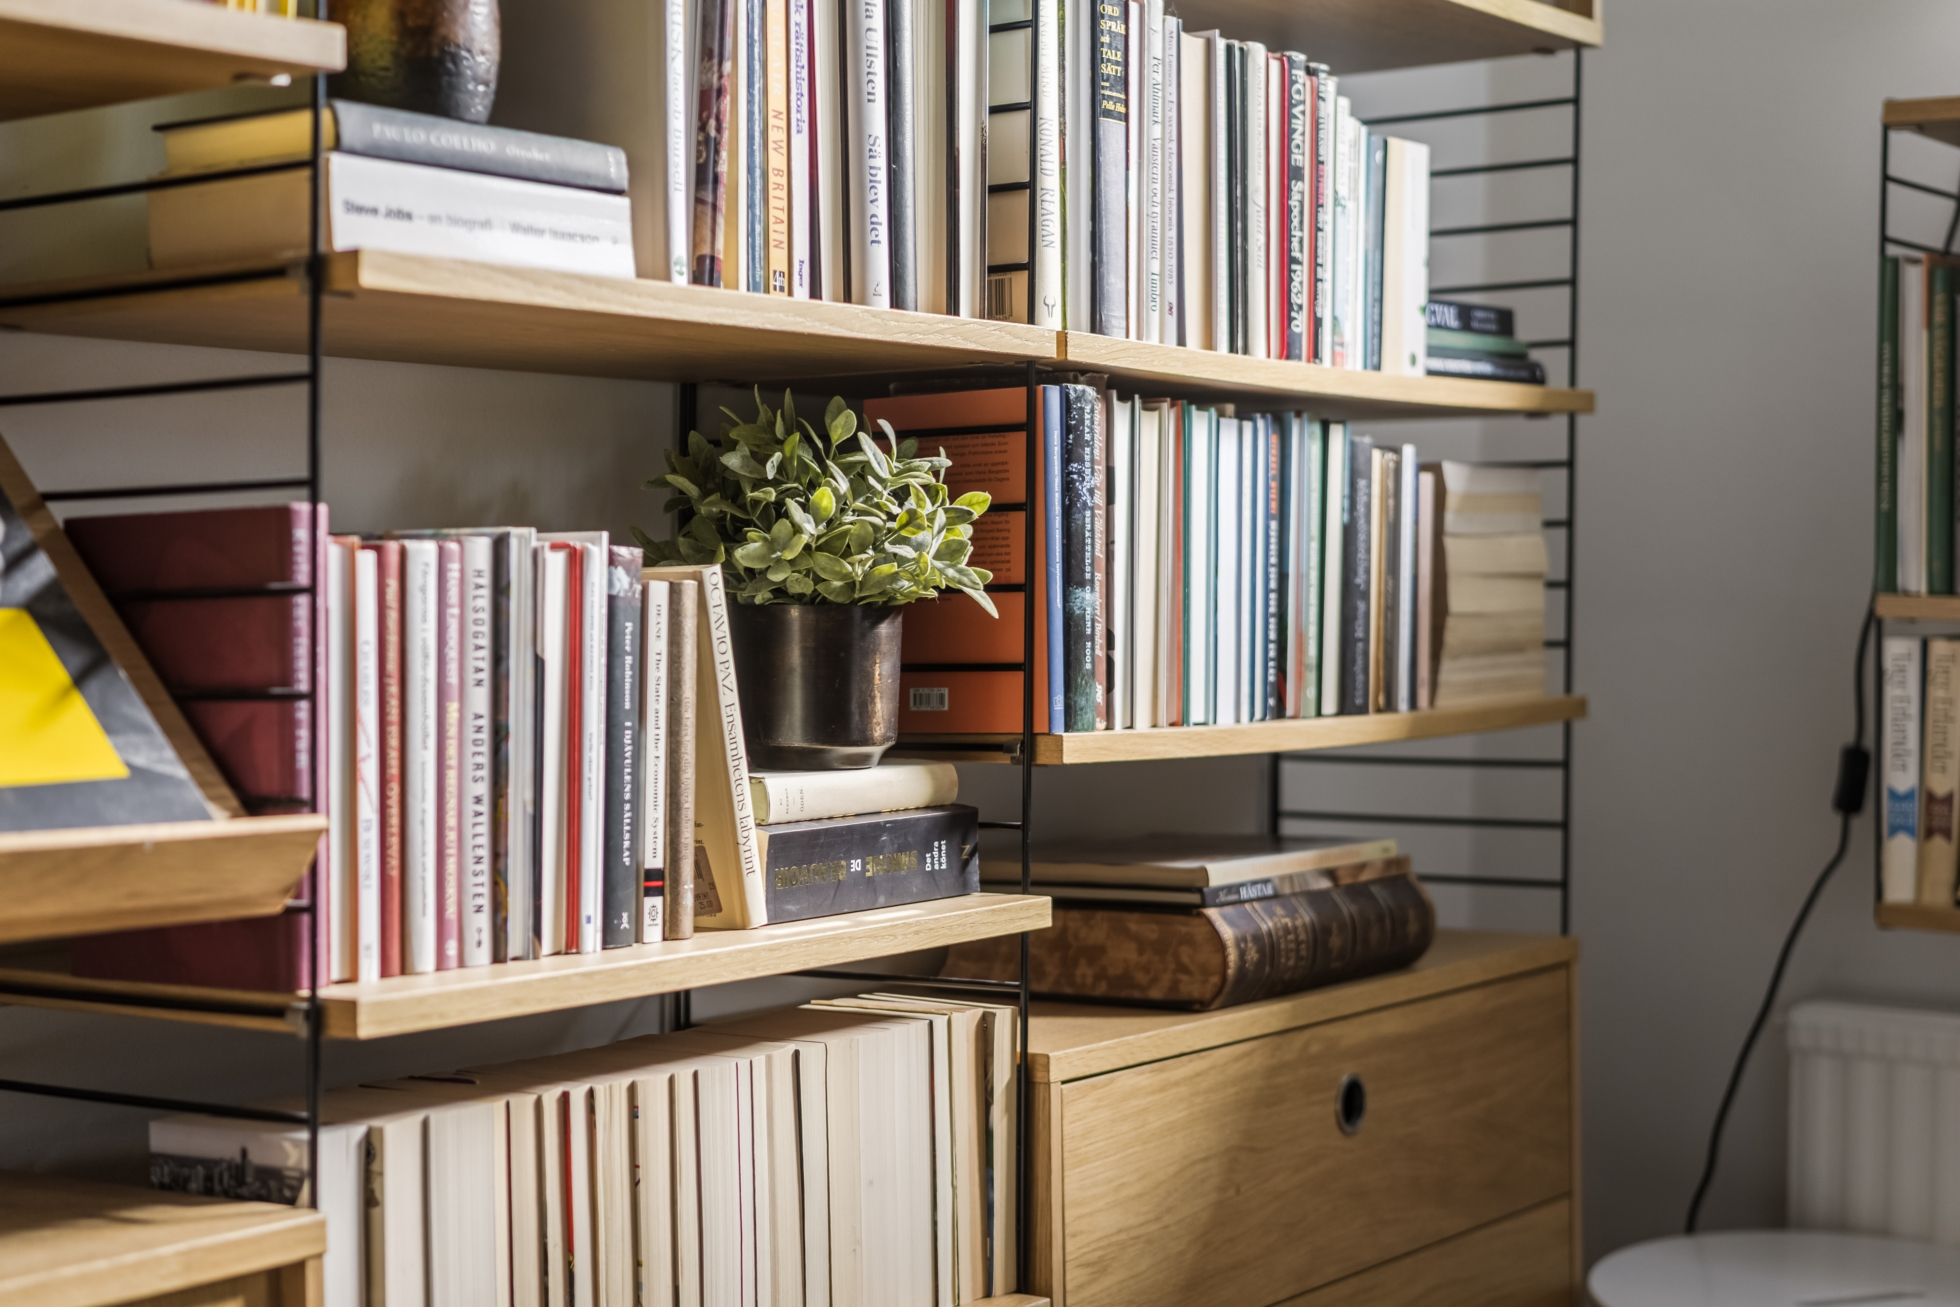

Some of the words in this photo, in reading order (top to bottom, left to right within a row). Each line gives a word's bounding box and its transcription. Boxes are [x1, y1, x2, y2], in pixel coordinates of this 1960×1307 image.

[1100, 4, 1120, 16] ORD
[864, 27, 879, 103] Ullsten
[1100, 48, 1122, 62] TALE
[1100, 63, 1122, 77] SÄTT
[1151, 56, 1161, 75] Per
[794, 21, 805, 135] rättshistoria
[1040, 64, 1051, 98] MIND
[1151, 77, 1161, 126] Ahlmark
[371, 121, 425, 146] PAULO
[429, 128, 497, 155] COELHO
[771, 109, 785, 156] NEW
[867, 134, 882, 160] Så
[1039, 117, 1056, 177] RONALD
[1151, 137, 1161, 185] Vänstern
[867, 164, 883, 209] blev
[1150, 188, 1161, 208] och
[341, 198, 379, 217] Steve
[381, 205, 414, 224] Jobs
[445, 211, 494, 232] biografi
[507, 221, 546, 237] Walter
[771, 167, 785, 251] BRITAIN
[1040, 187, 1056, 249] REAGAN
[1288, 181, 1304, 259] Säpochef
[868, 213, 883, 248] det
[797, 259, 805, 289] Inger
[1166, 236, 1175, 286] 1850-1985
[1150, 271, 1160, 312] Timbro
[1289, 264, 1303, 334] 1962-70
[1084, 447, 1092, 489] NESSER
[1094, 489, 1103, 507] till
[1085, 510, 1094, 580] BERÄTTELSE
[446, 563, 461, 605] HANS
[709, 571, 730, 656] OCTAVIO
[624, 622, 634, 653] Peter
[624, 655, 634, 710] Robinson
[653, 650, 663, 673] The
[718, 659, 734, 696] PAZ
[653, 675, 663, 704] State
[653, 707, 662, 731] and
[471, 712, 485, 784] ANDERS
[653, 733, 662, 753] the
[725, 702, 748, 812] Ensamhetens
[622, 729, 634, 801] DJÄVULENS
[652, 756, 662, 814] Economic
[471, 794, 485, 915] WALLENSTEN
[621, 803, 634, 867] SÄLLSKAP
[649, 816, 661, 859] System
[736, 815, 757, 878] labyrint
[932, 841, 940, 870] andra
[850, 858, 862, 872] DE
